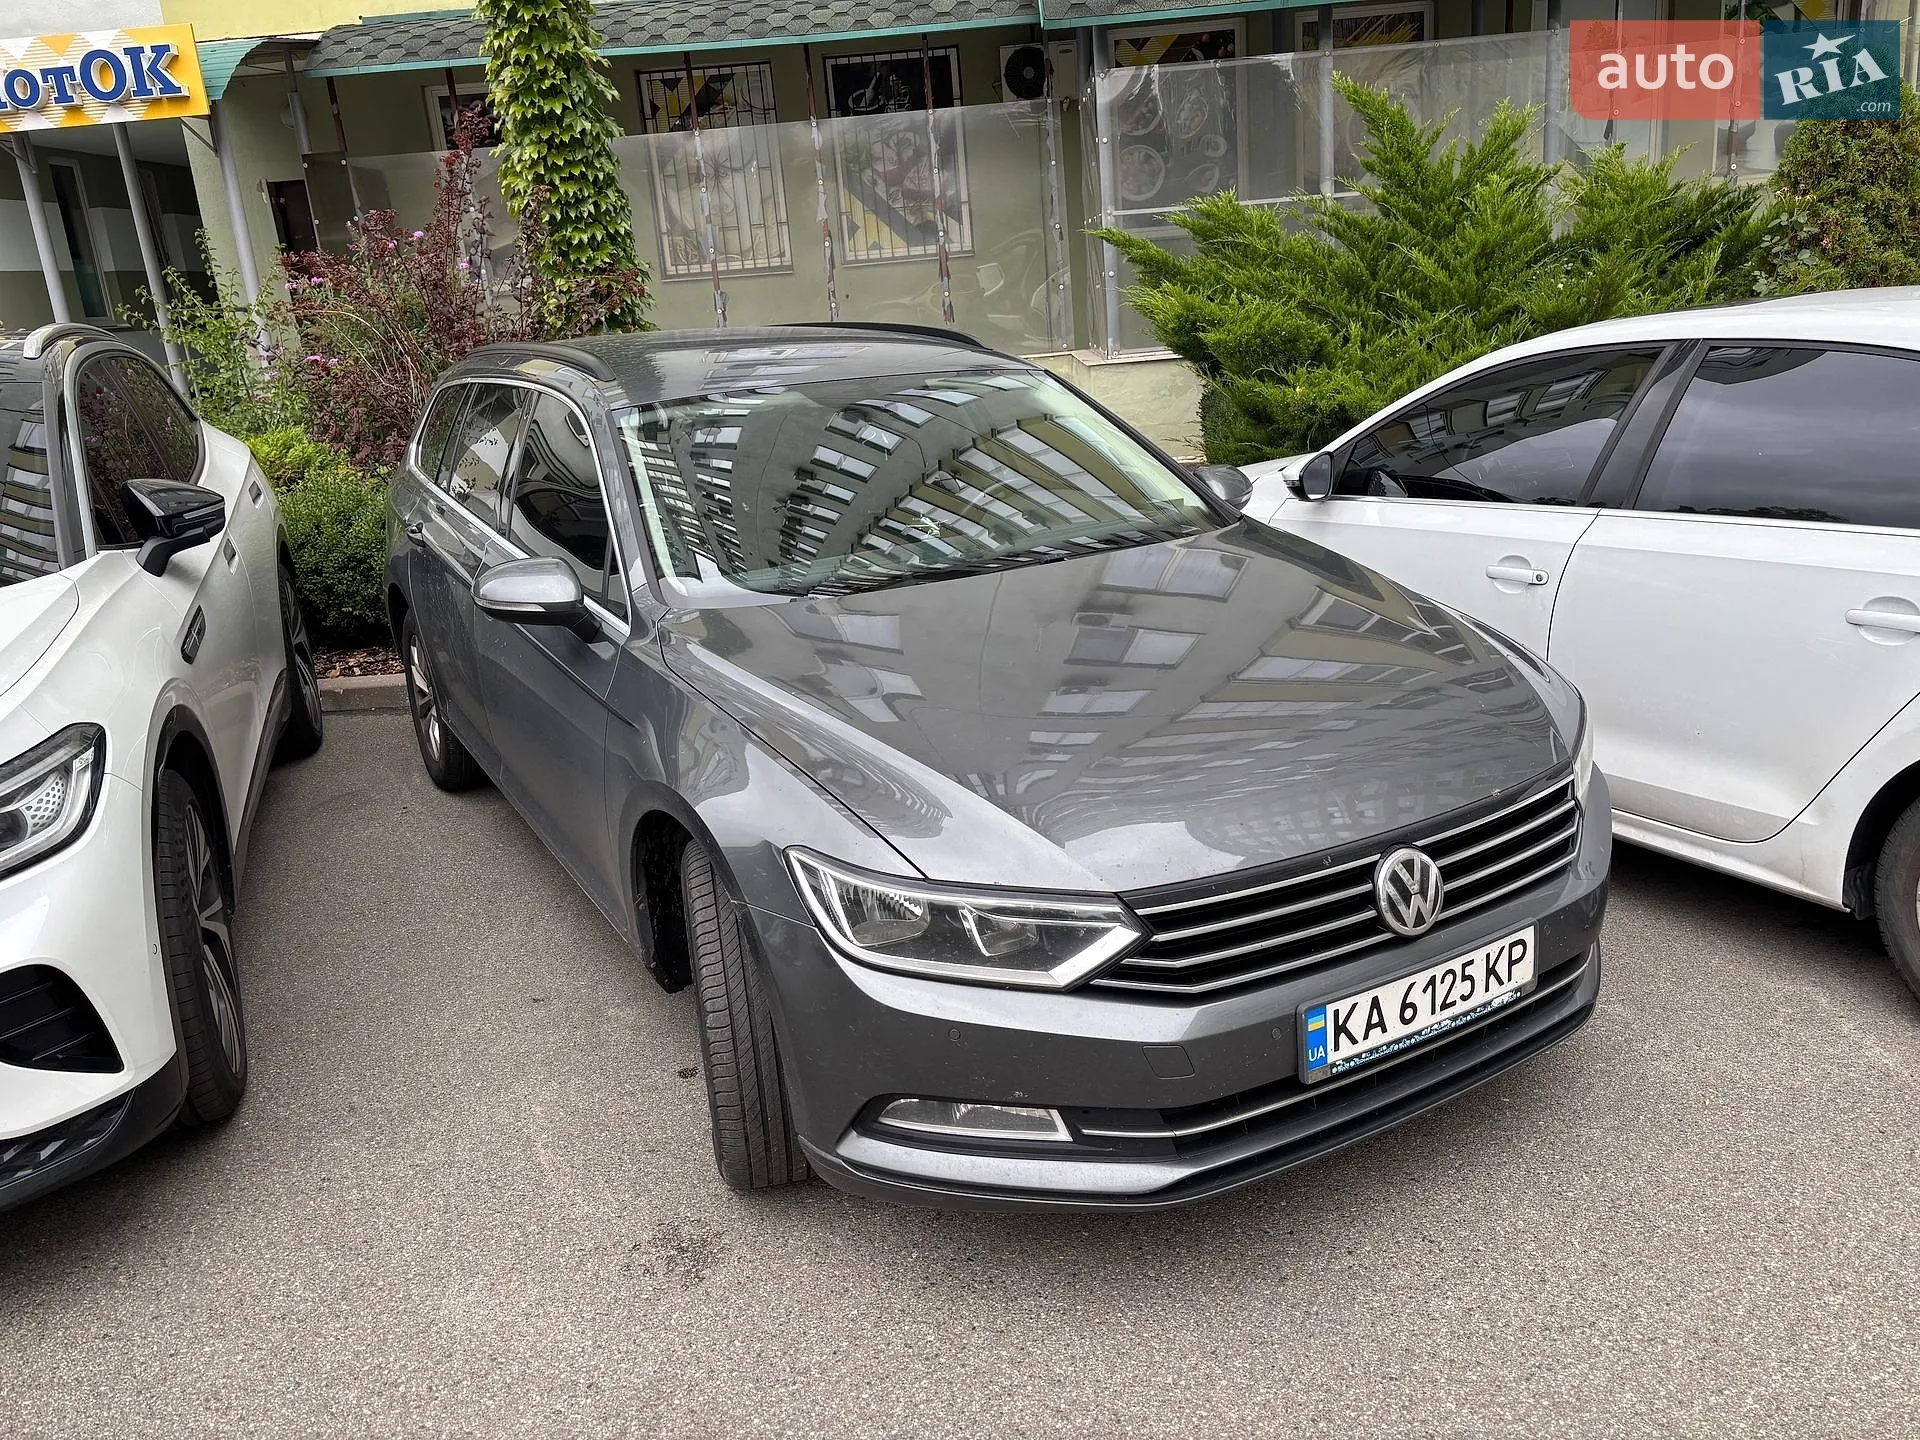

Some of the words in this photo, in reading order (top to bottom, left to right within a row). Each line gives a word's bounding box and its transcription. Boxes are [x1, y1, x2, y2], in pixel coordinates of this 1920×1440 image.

[0, 43, 185, 110] отОК
[1333, 995, 1388, 1052] KA
[1399, 959, 1476, 1026] 6125
[1484, 938, 1528, 993] KP
[1308, 1044, 1326, 1062] UA
